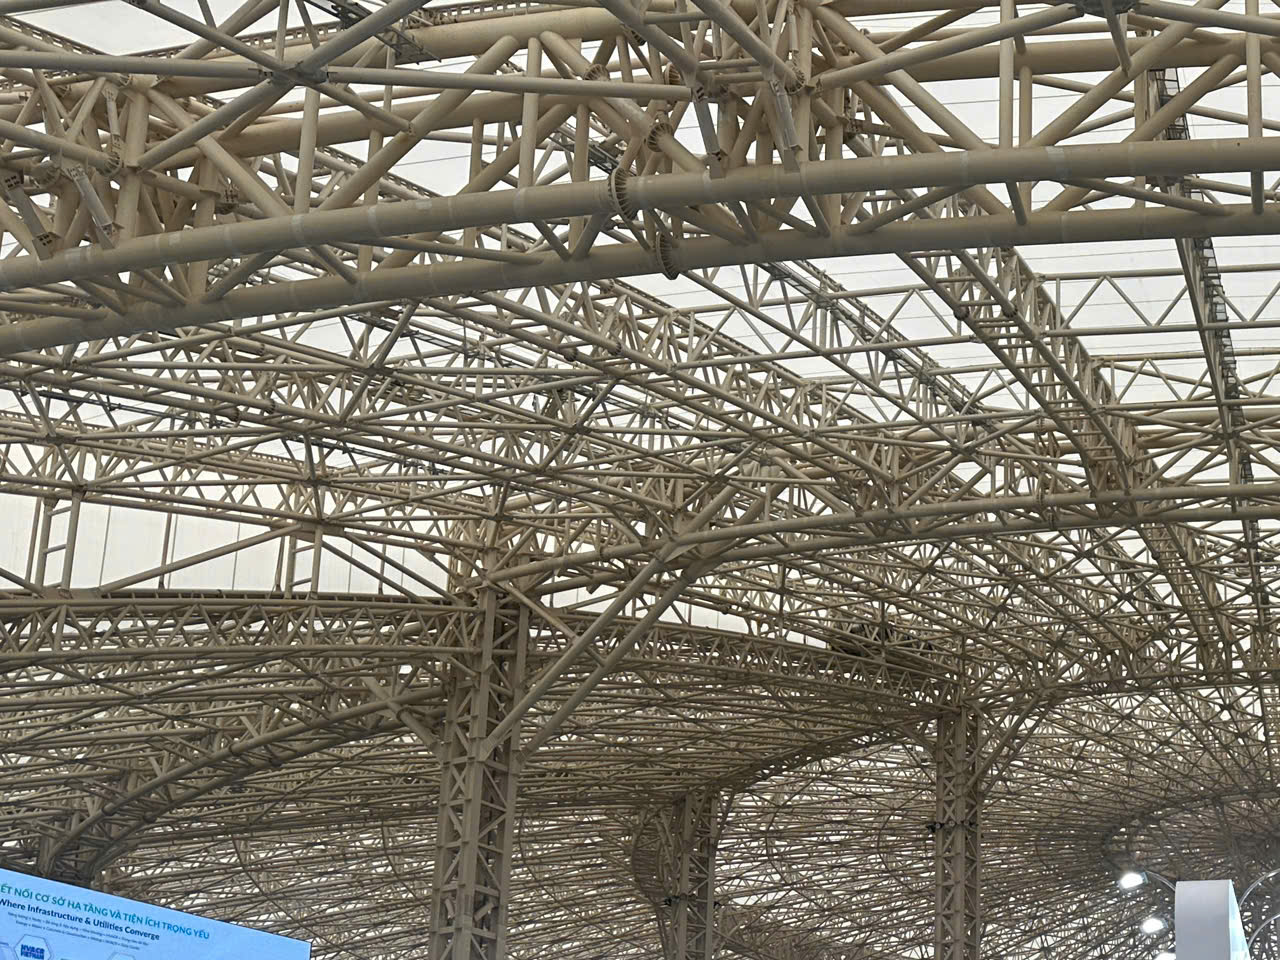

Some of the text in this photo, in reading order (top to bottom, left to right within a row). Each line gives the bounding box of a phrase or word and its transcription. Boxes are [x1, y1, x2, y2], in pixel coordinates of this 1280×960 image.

[14, 886, 210, 940] NỐI CƠ SỞ HẠ TẦNG VÀ TIỆN ÍCH TRỌNG YẾU
[27, 900, 84, 924] Infrastructure
[84, 916, 92, 925] &
[92, 918, 123, 933] Utilities
[124, 926, 160, 941] Converge
